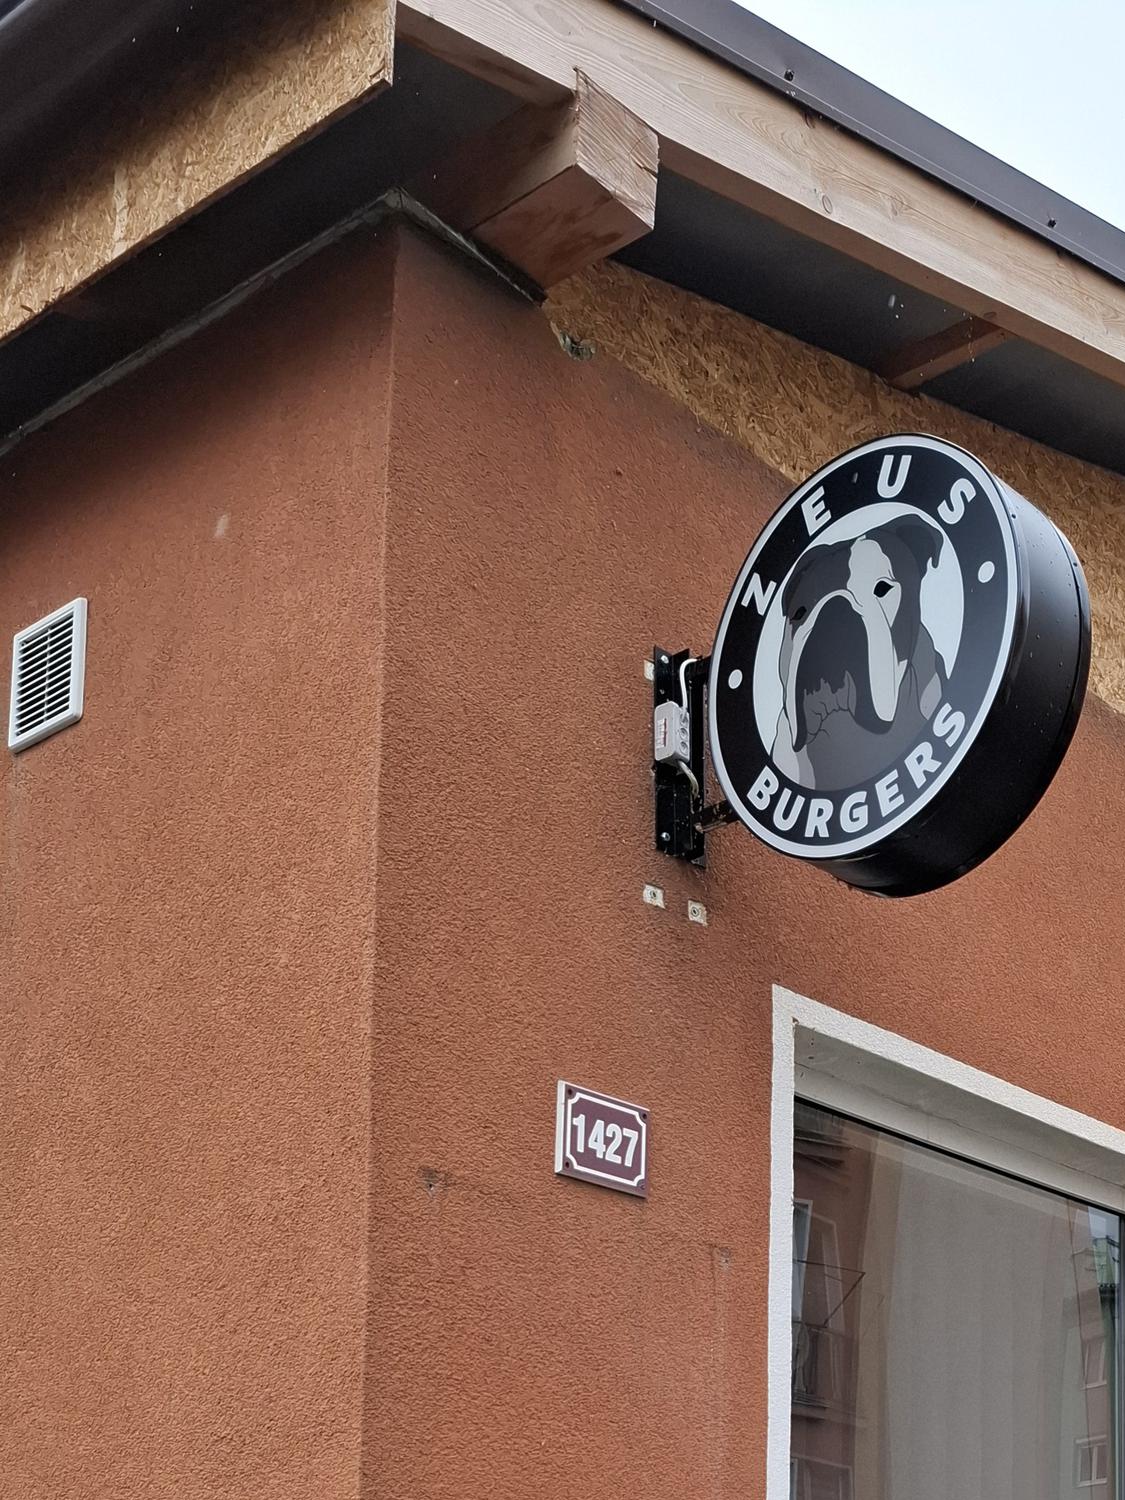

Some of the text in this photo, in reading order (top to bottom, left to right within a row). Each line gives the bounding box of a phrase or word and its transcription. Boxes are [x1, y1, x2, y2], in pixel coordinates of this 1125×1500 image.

[740, 453, 978, 617] ZEUS
[746, 704, 969, 839] BURGERS
[572, 1113, 639, 1168] 1427
